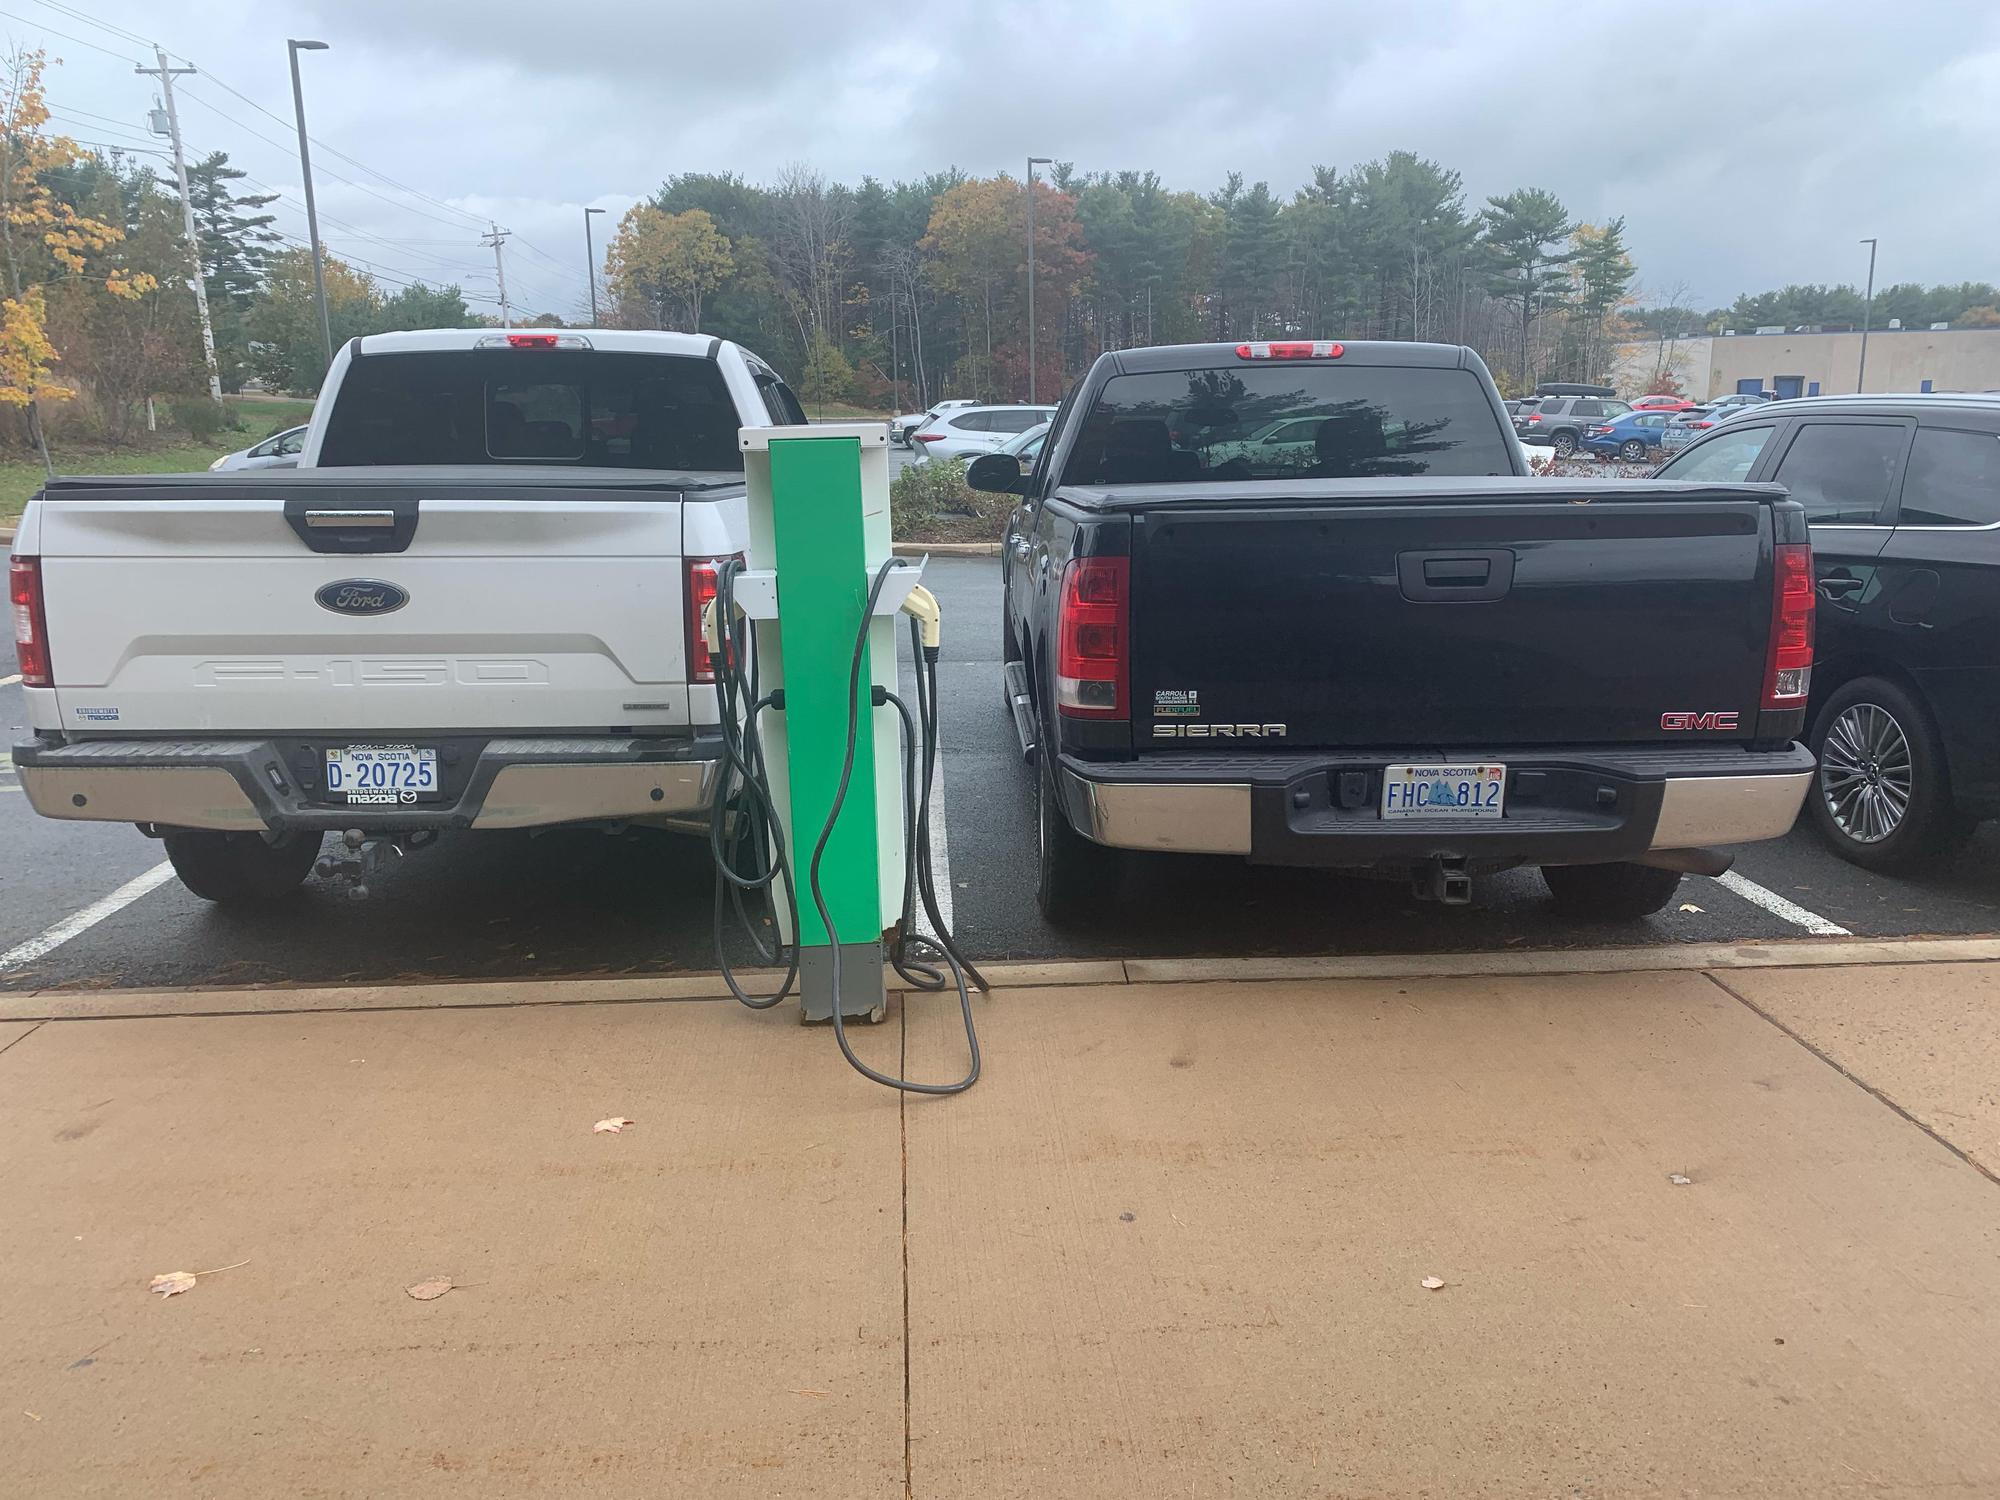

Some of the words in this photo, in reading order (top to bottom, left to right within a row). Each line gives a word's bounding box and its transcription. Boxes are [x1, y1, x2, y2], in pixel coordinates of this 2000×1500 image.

[336, 586, 385, 607] Ford
[192, 659, 550, 687] F-150
[1155, 690, 1187, 698] CARROLL
[1661, 712, 1739, 730] GMC
[1152, 724, 1287, 737] SIERRA
[351, 752, 373, 761] NOVA
[378, 752, 410, 760] SCOTIA
[328, 762, 432, 788] D-20725
[1414, 768, 1440, 777] NOVA
[1442, 768, 1477, 777] SCOTIA
[347, 794, 397, 804] mazda
[1388, 782, 1430, 808] FHC
[1457, 781, 1501, 807] 812
